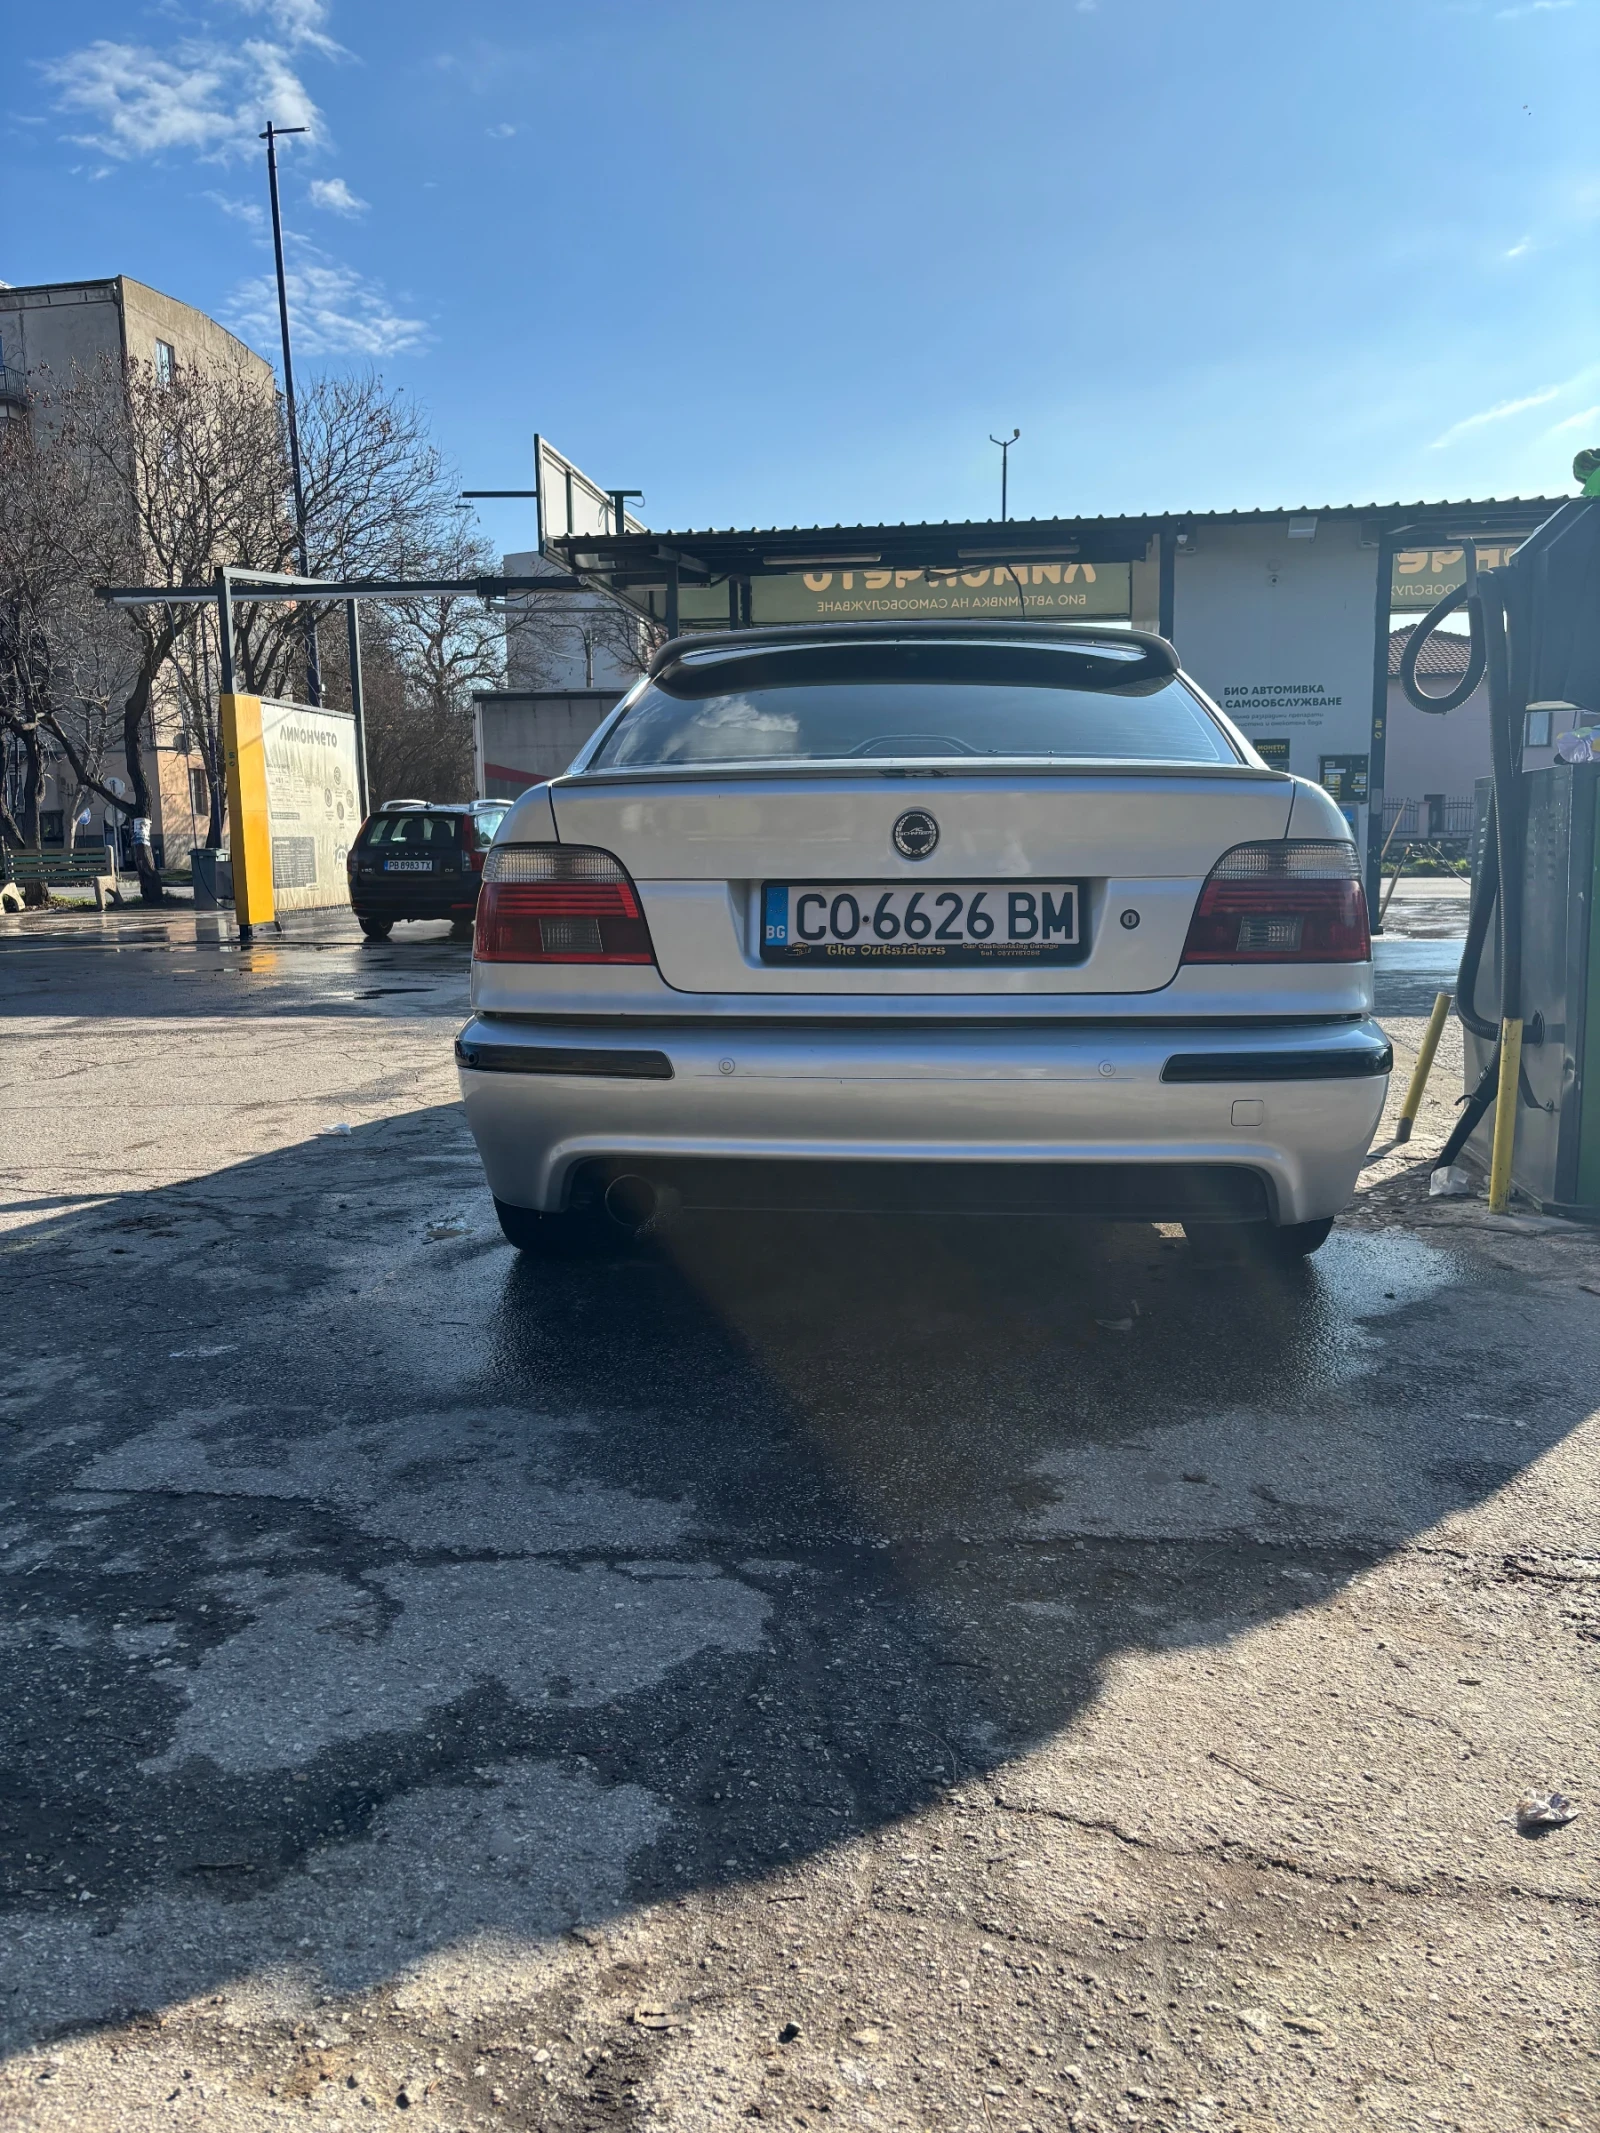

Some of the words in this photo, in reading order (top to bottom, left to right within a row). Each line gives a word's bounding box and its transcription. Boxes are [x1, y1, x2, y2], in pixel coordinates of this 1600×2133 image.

[1224, 687, 1248, 696] БИО
[1251, 685, 1325, 695] АВТОМИВКА
[1225, 697, 1342, 709] САМООБСЛУЖВАНЕ
[421, 861, 431, 870] TX
[872, 892, 995, 940] 6626
[1007, 891, 1074, 940] BM
[766, 925, 786, 939] BG
[825, 943, 856, 955] The
[860, 943, 946, 956] Outsiders
